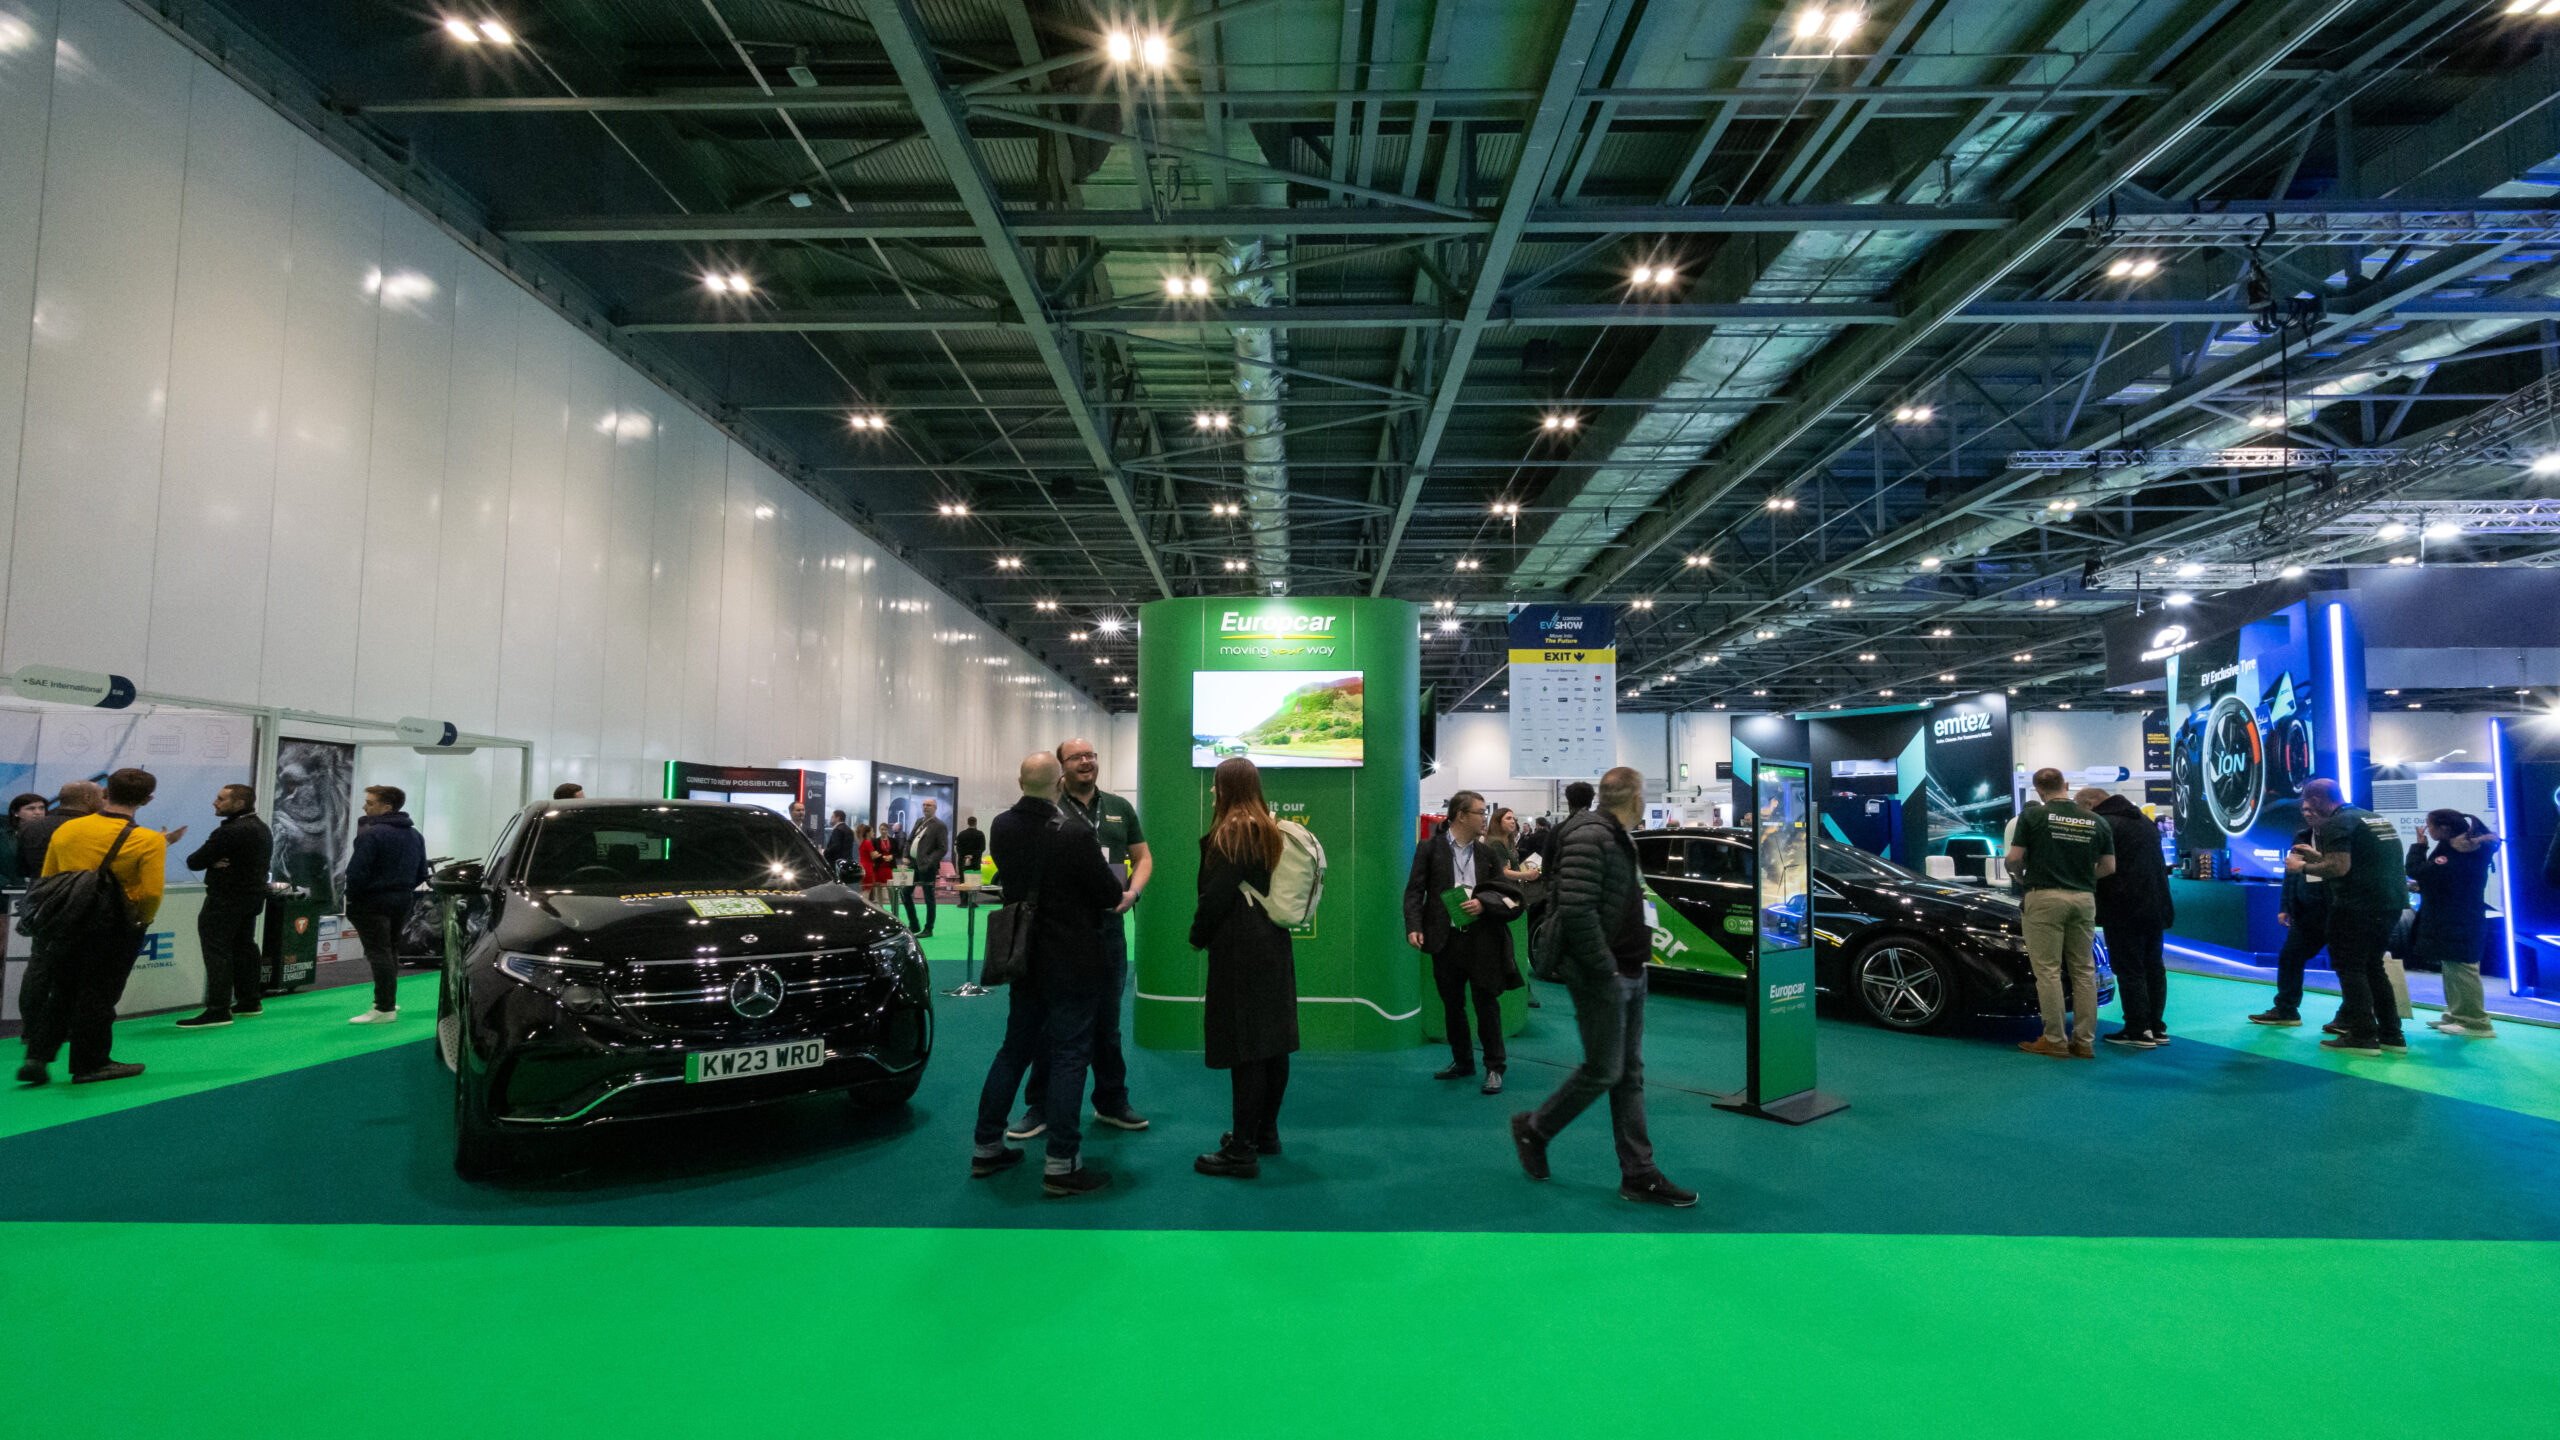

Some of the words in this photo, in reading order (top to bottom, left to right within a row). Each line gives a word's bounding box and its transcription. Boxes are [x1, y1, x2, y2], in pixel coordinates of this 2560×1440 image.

[1220, 611, 1336, 639] Europcar
[1554, 621, 1584, 630] SHOW
[1220, 645, 1269, 658] moving
[1272, 647, 1304, 655] your
[1306, 646, 1335, 657] way
[1544, 652, 1571, 661] EXIT
[2201, 673, 2212, 687] EV
[2211, 663, 2240, 684] Exclusive
[2240, 659, 2257, 675] Tyre
[28, 678, 48, 687] SAE
[50, 681, 103, 694] International
[1934, 712, 1991, 737] emtez
[2218, 751, 2247, 775] iON
[686, 776, 710, 784] CONNECT
[1282, 803, 1305, 812] our
[2048, 813, 2096, 827] Europcar
[620, 891, 673, 900] FREE
[283, 961, 314, 973] ELECTRONIC
[282, 969, 307, 982] EXHAUST
[1769, 983, 1806, 1000] Europcar
[703, 1050, 768, 1077] KW23
[776, 1043, 820, 1068] WRO
